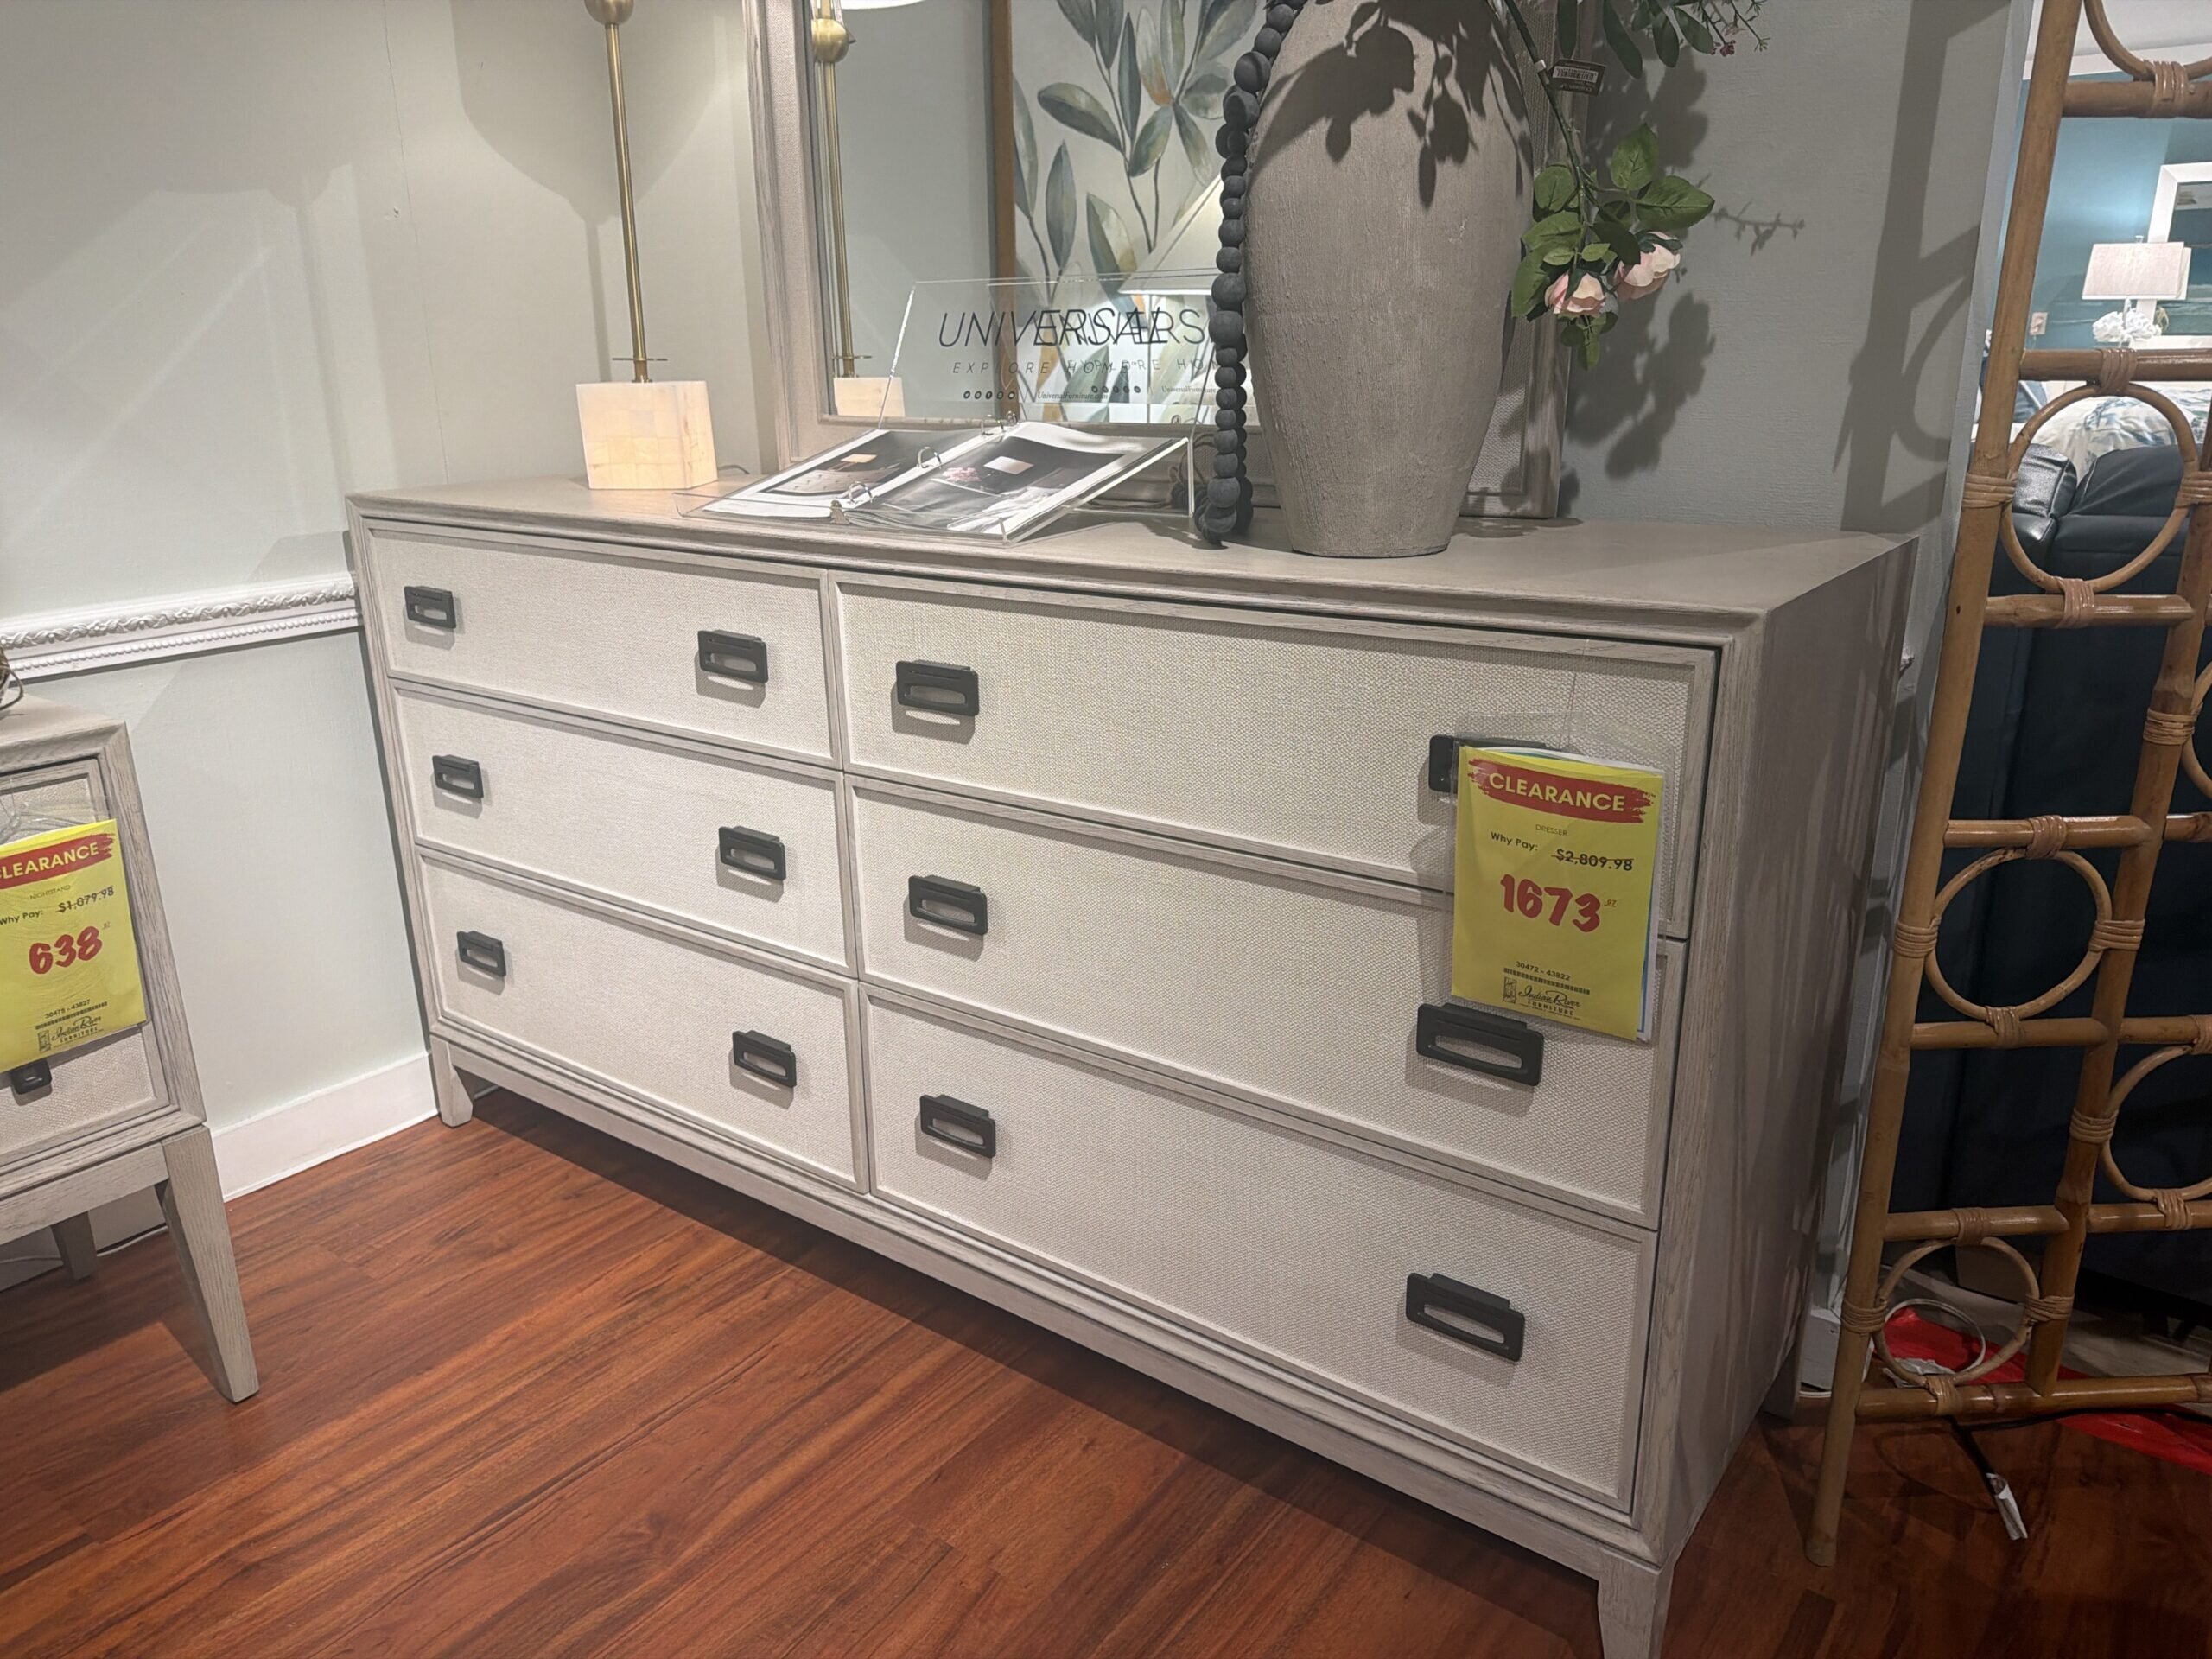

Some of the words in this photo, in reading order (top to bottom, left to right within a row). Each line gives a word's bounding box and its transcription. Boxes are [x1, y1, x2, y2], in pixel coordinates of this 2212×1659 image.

[938, 307, 1168, 347] UNIVERSAL
[952, 361, 1051, 374] EXPLORE
[1489, 772, 1626, 812] CLEARANCE
[1490, 830, 1513, 846] Why
[1516, 838, 1539, 852] Pay:
[1535, 823, 1568, 837] DRESSER
[0, 842, 99, 880] LEARANCE
[1554, 848, 1634, 872] $2,809.98
[57, 885, 115, 913] $1,079.98
[1500, 874, 1601, 933] 1673
[0, 915, 20, 926] Why
[29, 925, 103, 976] 638
[1515, 961, 1539, 974] 30472
[1546, 969, 1571, 982] 43822
[1518, 984, 1554, 1004] Indian
[1545, 989, 1582, 1010] River
[1527, 1000, 1574, 1017] FURNITURE
